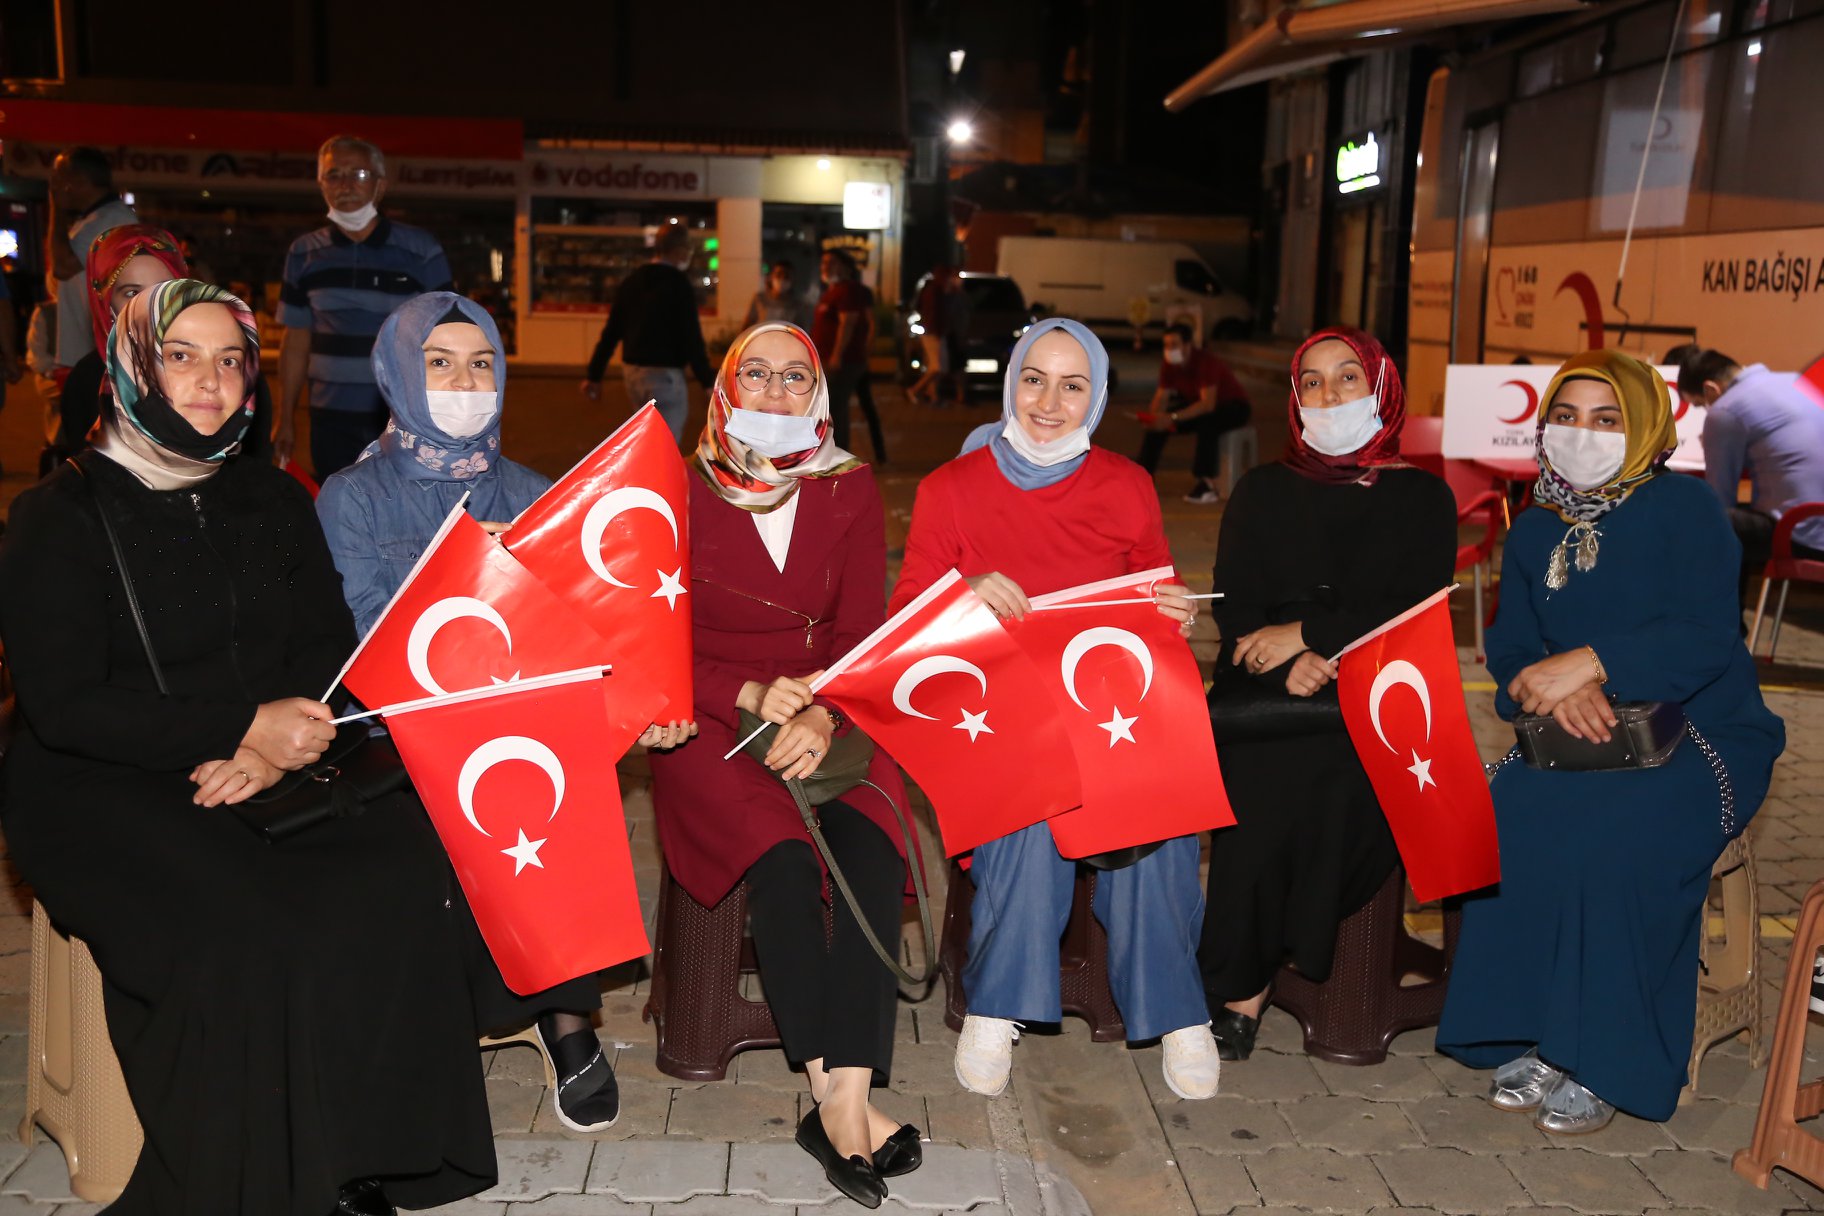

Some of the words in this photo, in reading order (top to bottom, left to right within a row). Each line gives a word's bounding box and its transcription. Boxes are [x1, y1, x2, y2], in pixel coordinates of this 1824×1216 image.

[557, 162, 698, 191] vodafone
[1702, 259, 1739, 292] KAN
[1744, 251, 1811, 302] BAĞIŞI
